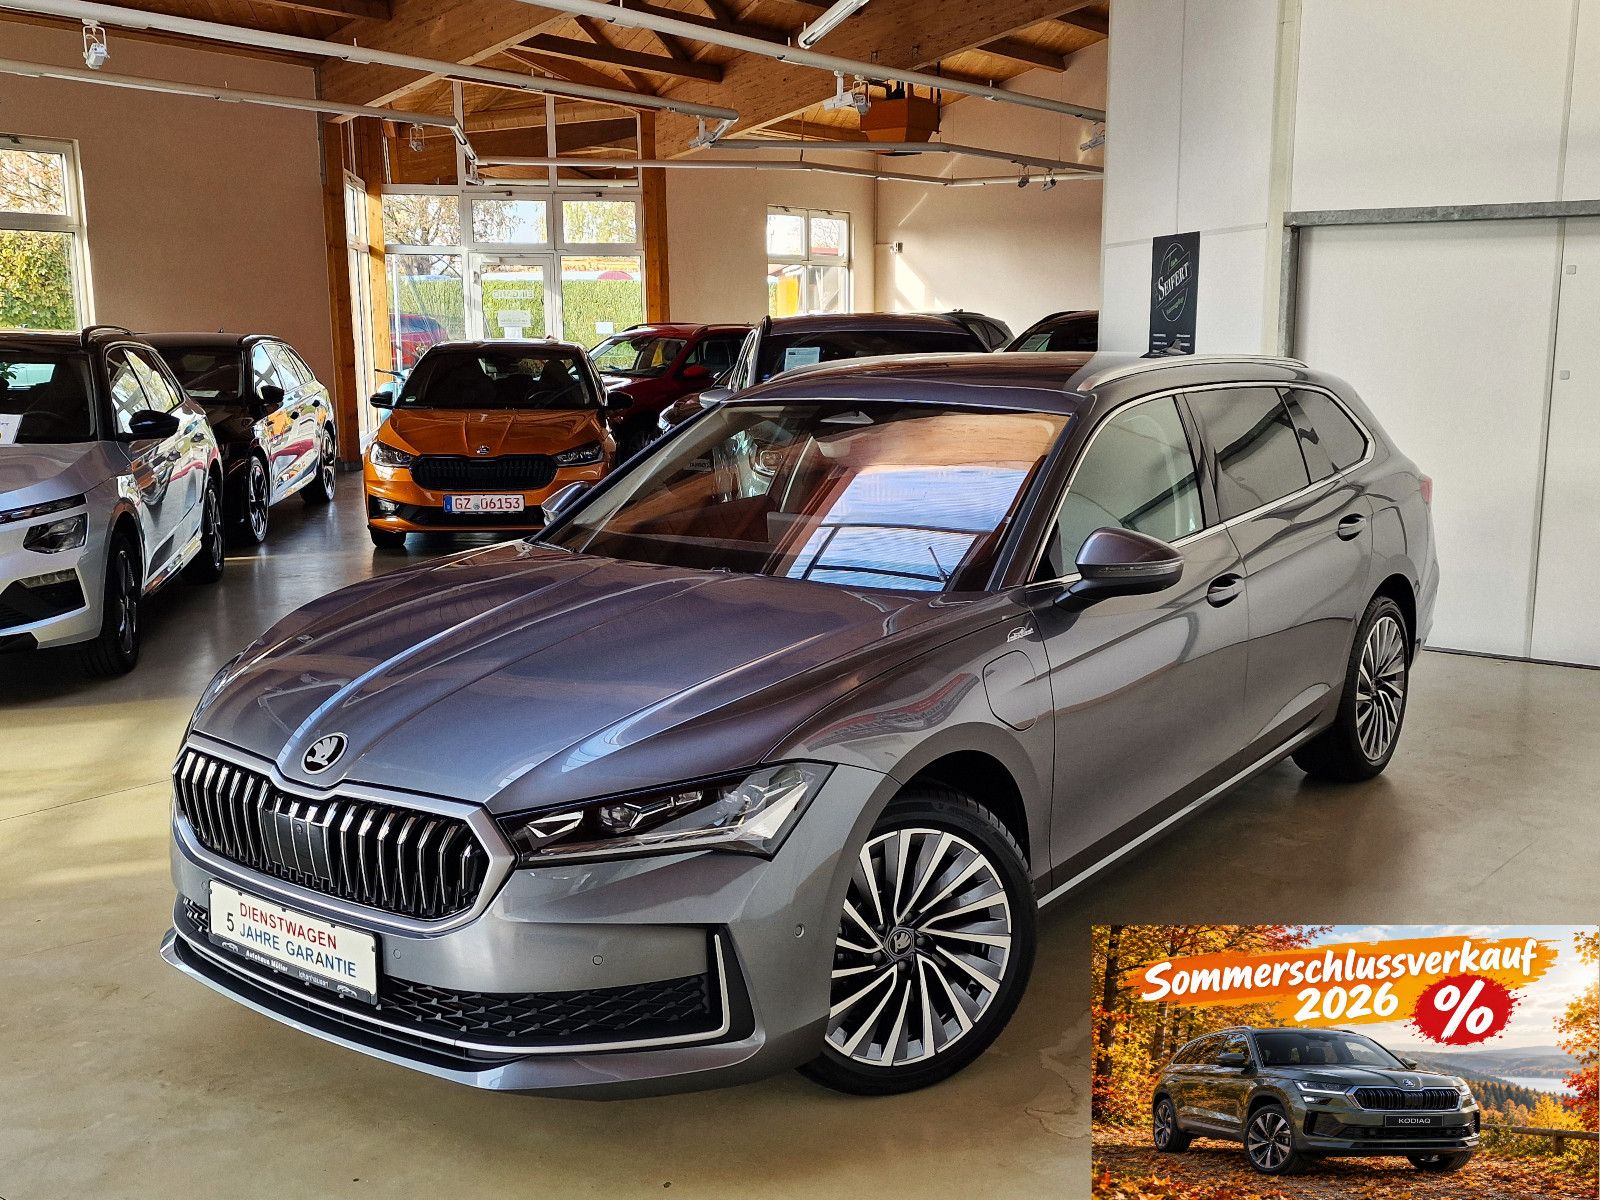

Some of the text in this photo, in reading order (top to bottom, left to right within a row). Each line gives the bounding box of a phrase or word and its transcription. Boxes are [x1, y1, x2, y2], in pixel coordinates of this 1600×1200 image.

[455, 497, 520, 509] GZ 06153
[239, 902, 337, 950] DIENSTWAGEN
[226, 912, 357, 978] 5 JAHRE GARANTIE
[245, 949, 270, 965] Autohaus
